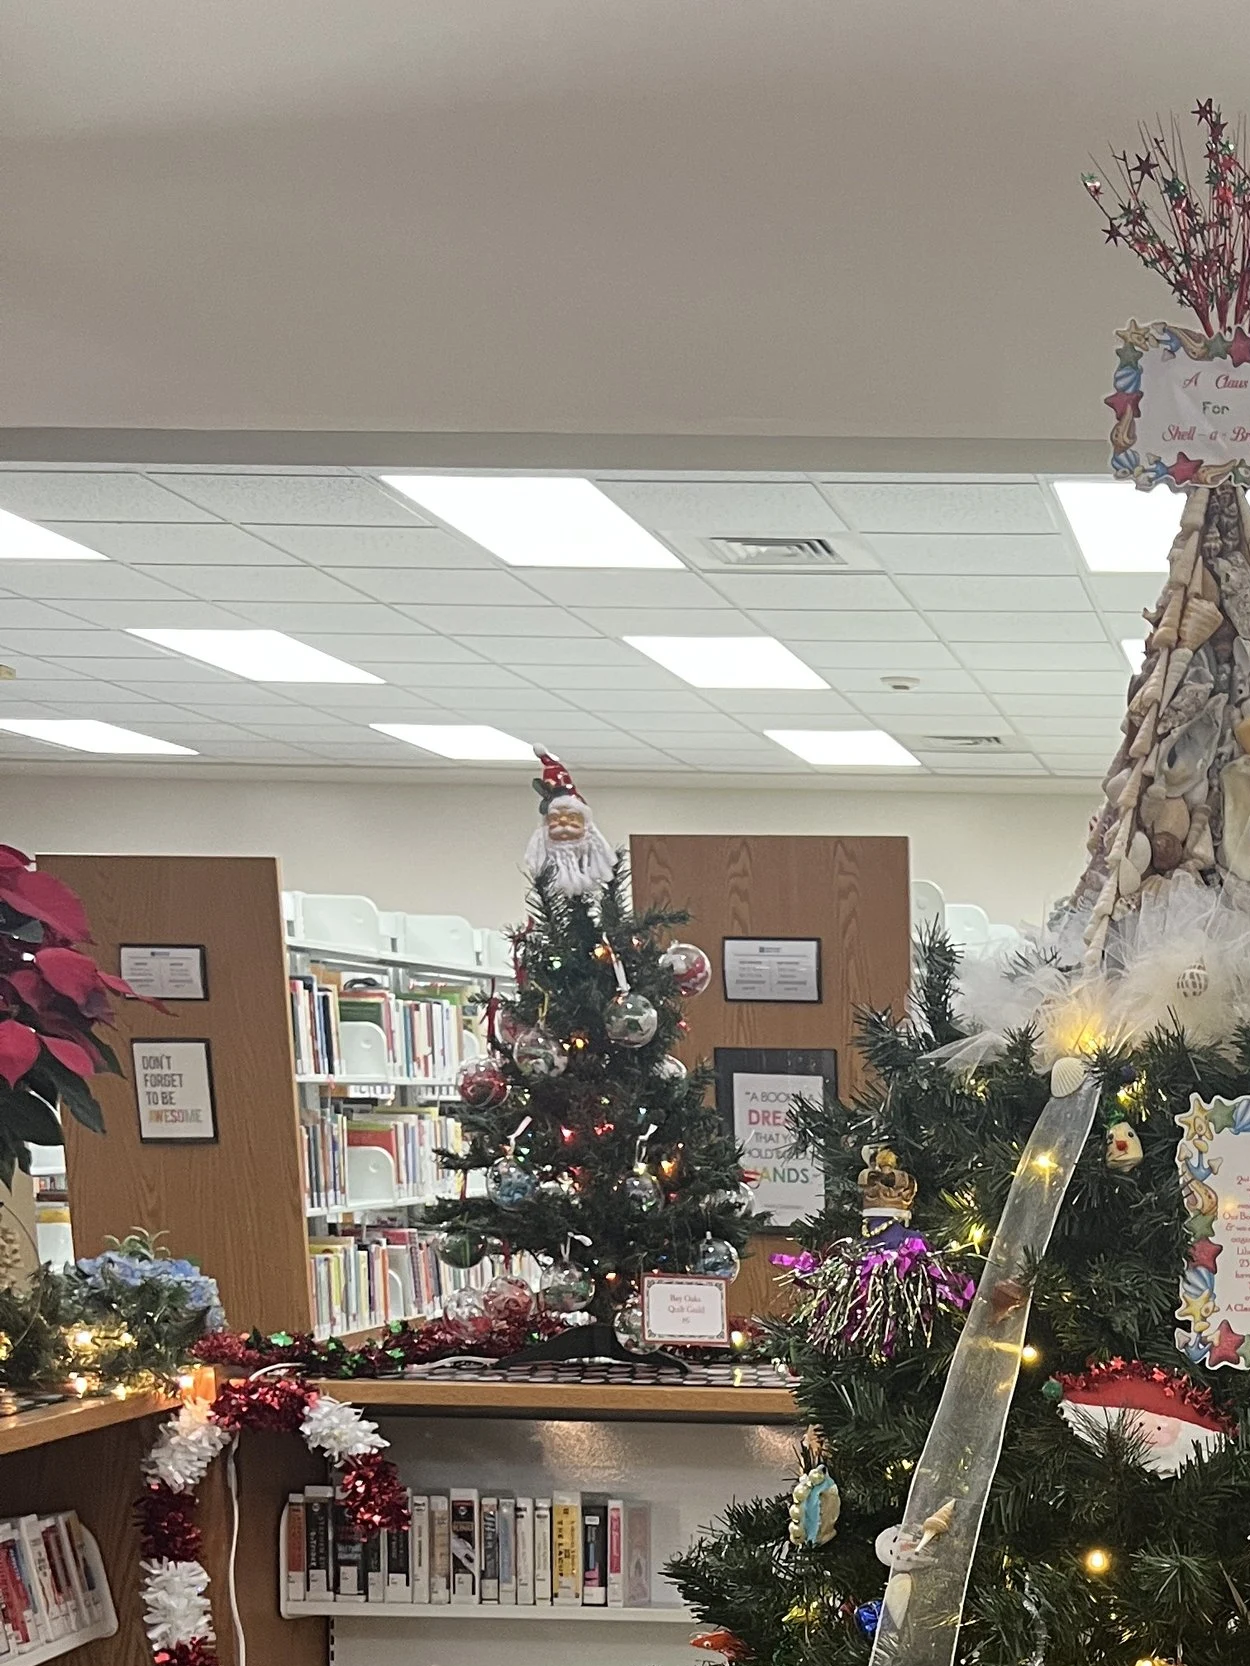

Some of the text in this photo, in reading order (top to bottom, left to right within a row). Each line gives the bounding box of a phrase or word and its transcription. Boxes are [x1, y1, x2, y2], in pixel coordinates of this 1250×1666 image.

[1183, 372, 1249, 389] A Claus
[1202, 401, 1230, 415] For
[144, 1073, 184, 1088] FORGET
[146, 1091, 176, 1106] TO BE
[148, 1109, 203, 1123] AWESOME
[748, 1109, 796, 1126] DRE
[758, 1167, 809, 1183] ANDS
